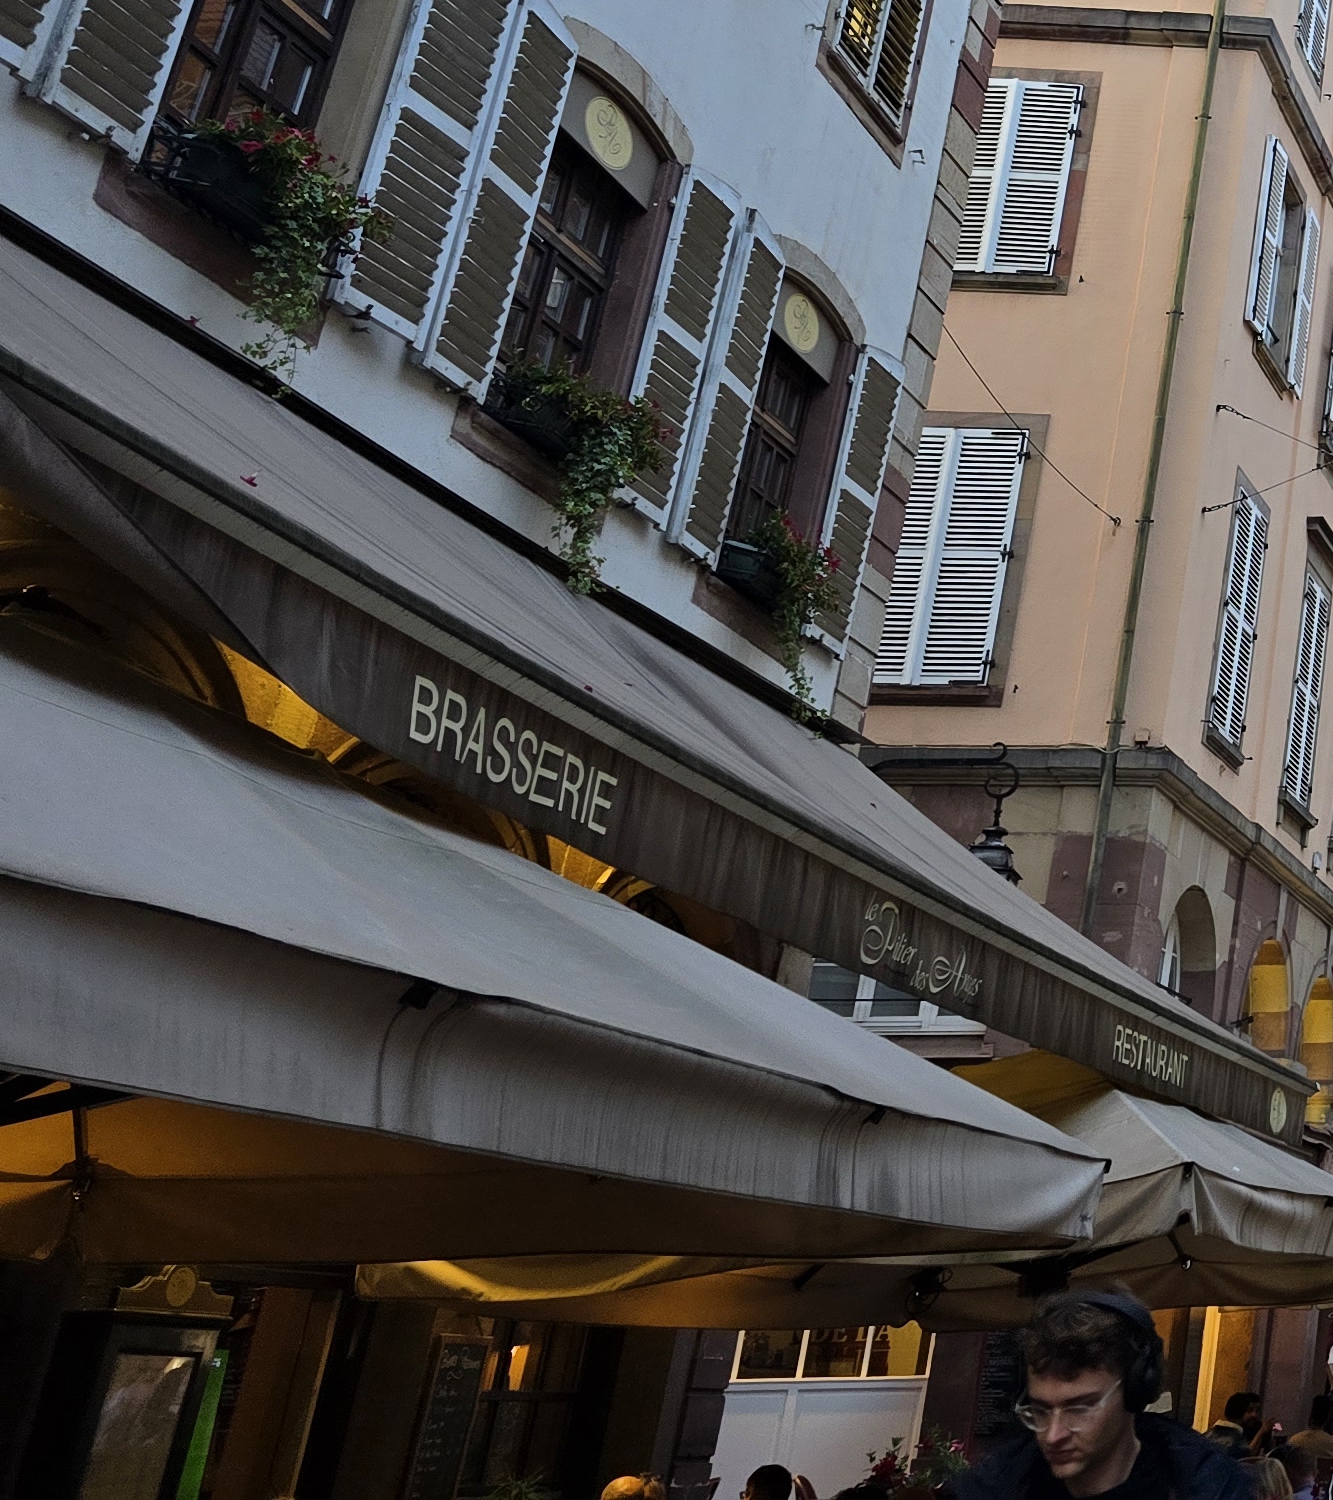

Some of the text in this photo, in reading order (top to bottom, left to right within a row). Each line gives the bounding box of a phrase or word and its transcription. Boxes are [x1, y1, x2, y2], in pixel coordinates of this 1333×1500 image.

[409, 674, 619, 835] BRASSERIE
[860, 891, 918, 965] le Pilier
[1112, 1024, 1189, 1089] RESTAURANT
